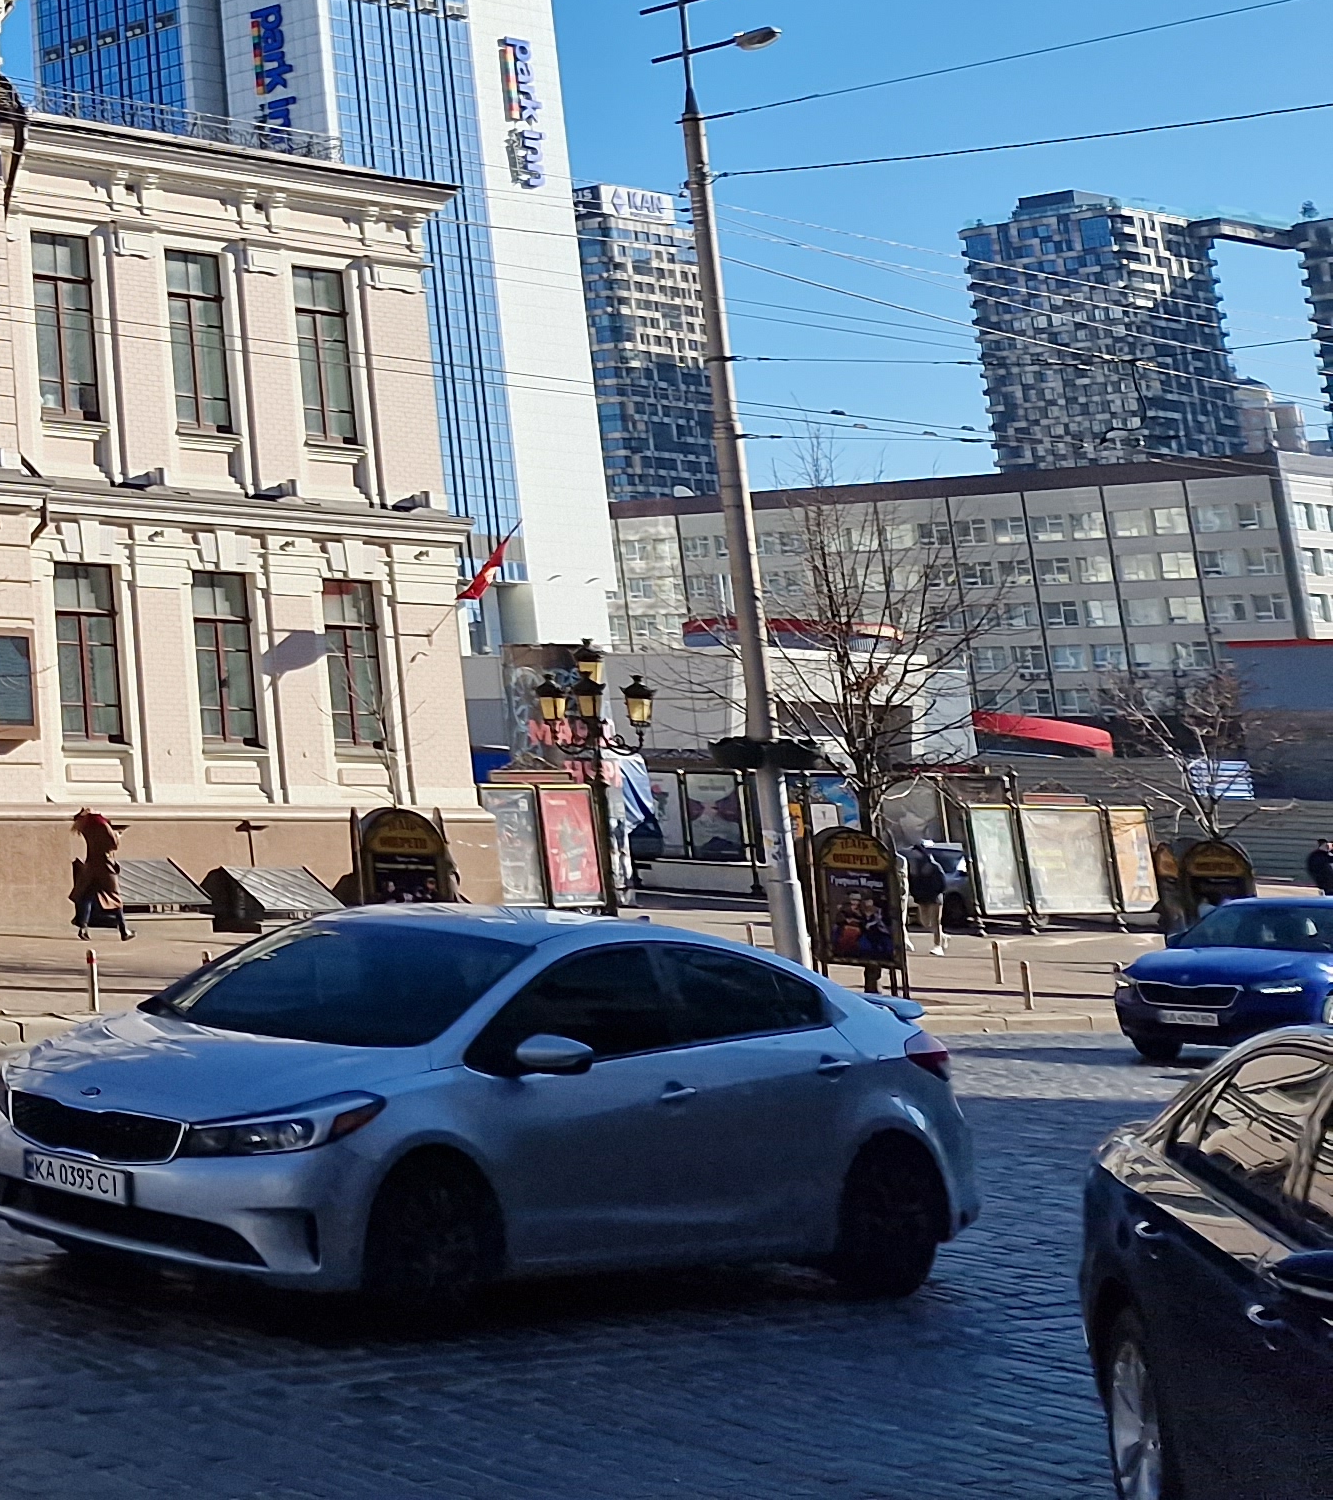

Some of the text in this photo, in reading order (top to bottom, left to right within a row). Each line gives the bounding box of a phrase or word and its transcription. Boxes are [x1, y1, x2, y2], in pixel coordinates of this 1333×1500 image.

[250, 4, 293, 94] park
[504, 36, 543, 124] park
[522, 130, 547, 188] inn
[627, 191, 664, 214] KAN
